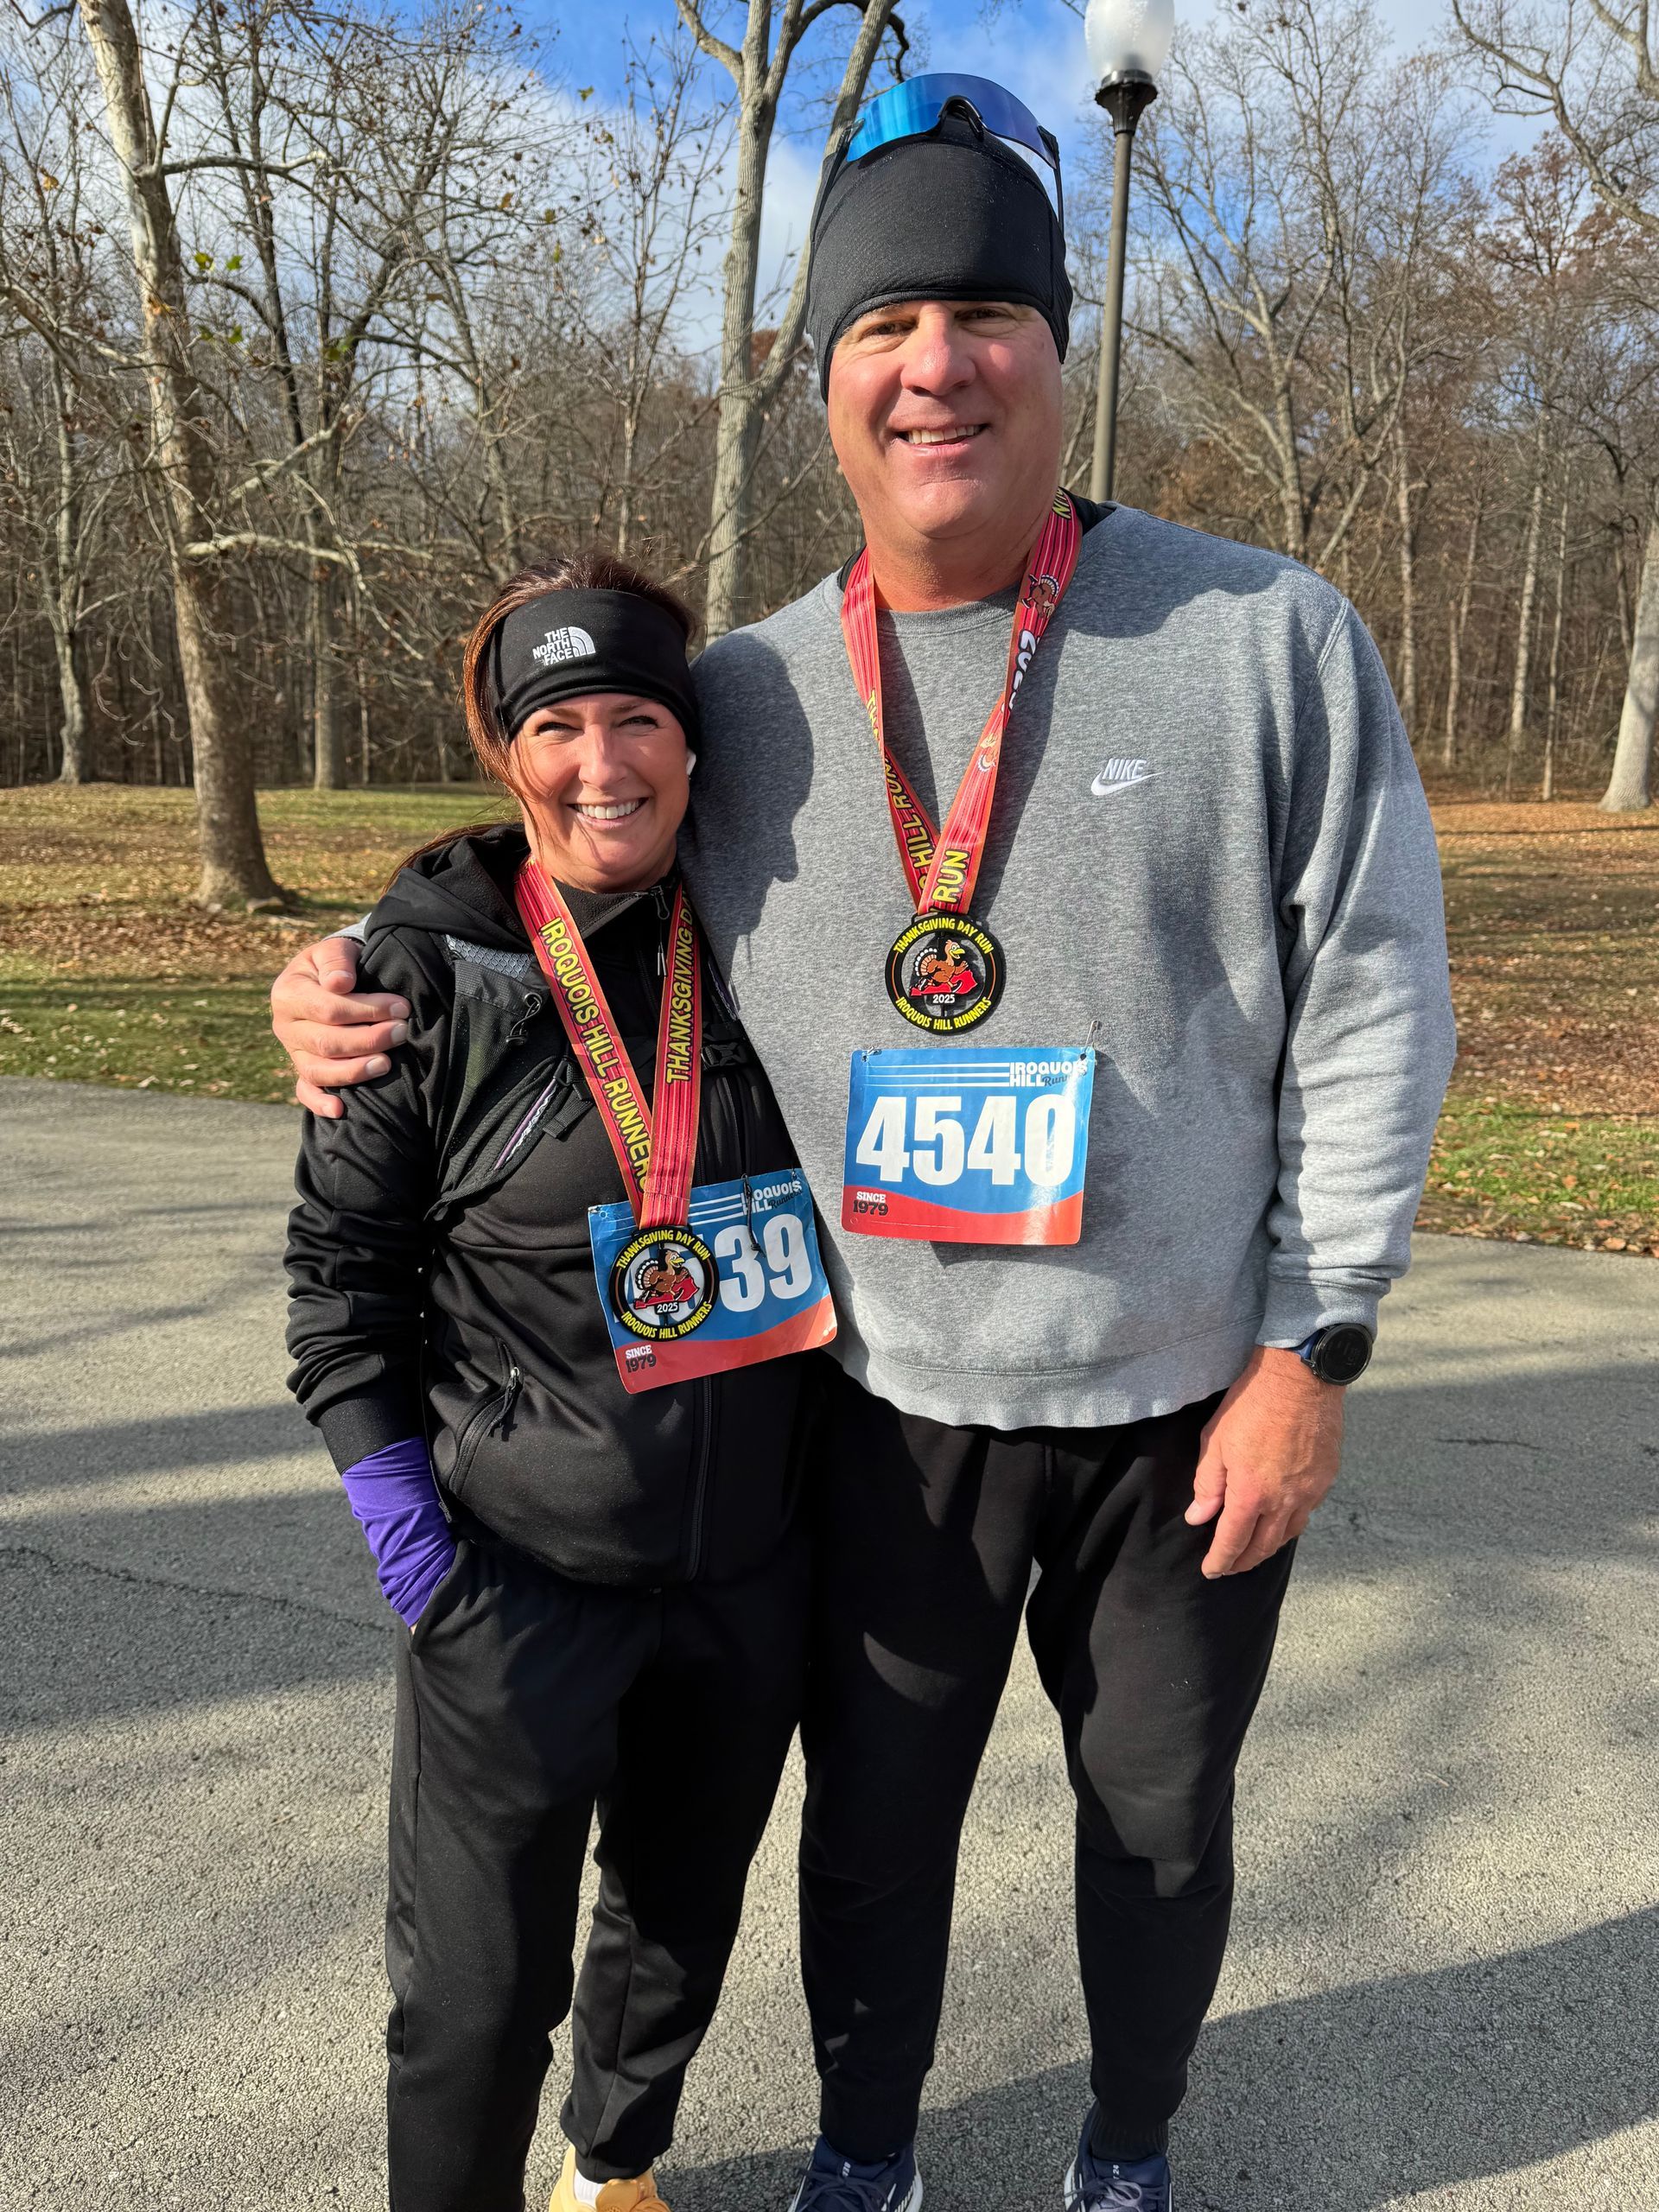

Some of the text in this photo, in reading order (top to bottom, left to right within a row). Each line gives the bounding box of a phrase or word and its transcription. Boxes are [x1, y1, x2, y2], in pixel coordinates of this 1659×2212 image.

[544, 627, 569, 642] THE
[532, 638, 570, 658] NORTH
[543, 648, 574, 665] FACE
[1102, 759, 1147, 779] NIKE
[903, 813, 935, 868] HILL
[932, 850, 969, 903] RUN
[893, 918, 994, 954] THANKSGIVING DAY RUN
[540, 917, 600, 1025] IROQUOIS
[581, 1023, 620, 1077] HILL
[665, 926, 695, 1084] THANKSGIVING
[933, 994, 955, 1003] 2025
[895, 996, 992, 1030] IROQUOIS HILL RUNNERS
[1009, 1074, 1046, 1087] HILL
[855, 1094, 1077, 1186] 4540
[741, 1180, 802, 1204] IOQUOIS
[856, 1191, 886, 1203] SINCE
[853, 1199, 888, 1216] 1979
[616, 1230, 710, 1268] THANKSGIVING DAY RUN
[657, 1303, 678, 1313] 2025
[620, 1301, 713, 1338] IROQUOIS HILL RUNNERS
[626, 1344, 652, 1359] SINCE
[626, 1354, 657, 1373] 1979
